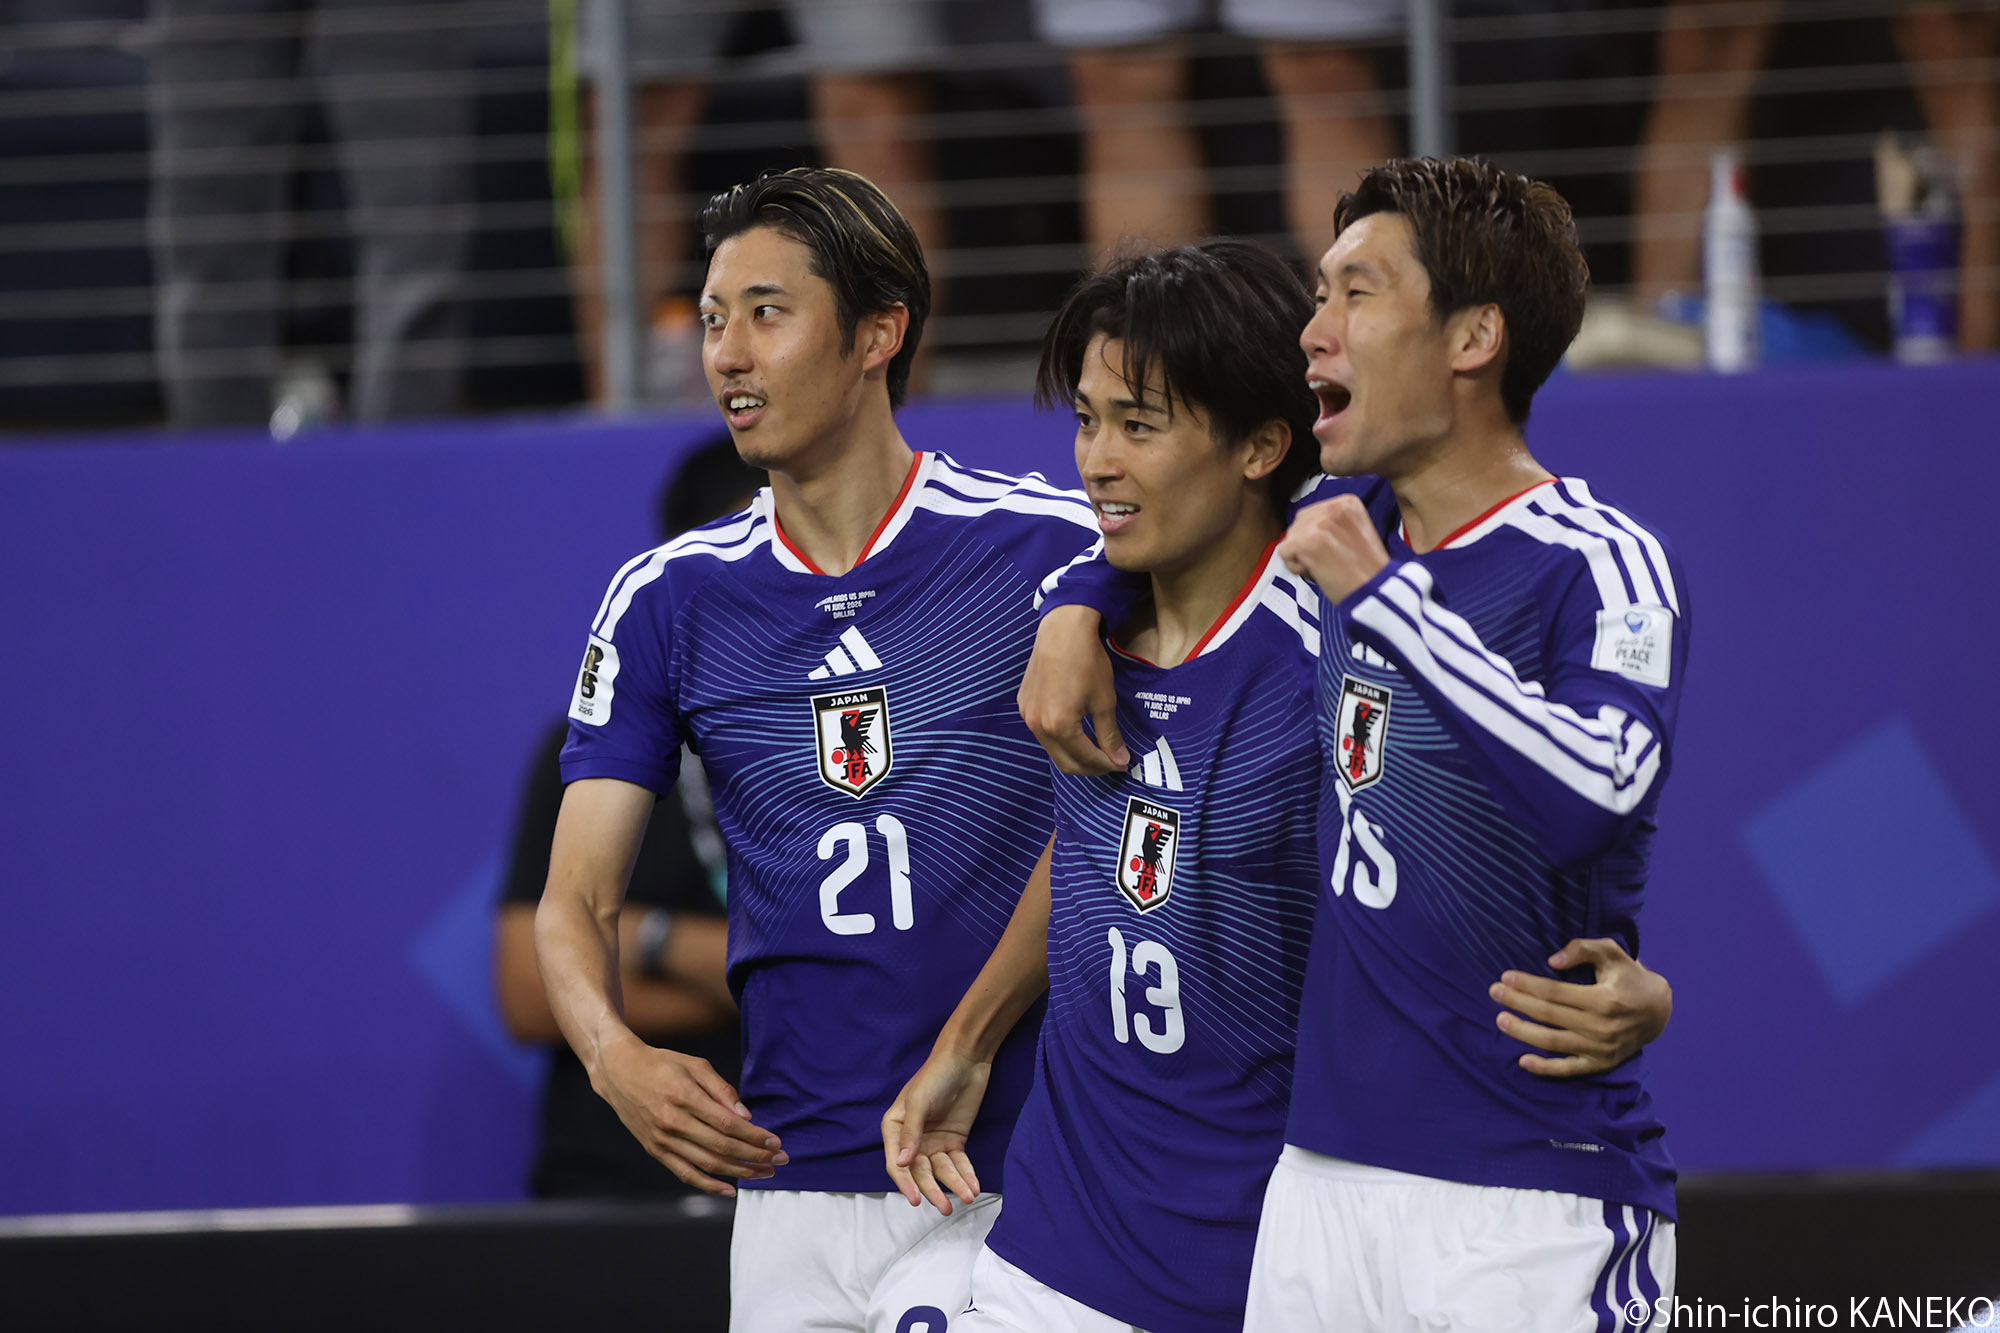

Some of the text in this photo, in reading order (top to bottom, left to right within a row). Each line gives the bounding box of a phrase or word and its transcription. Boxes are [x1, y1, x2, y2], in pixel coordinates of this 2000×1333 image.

[858, 590, 876, 599] JAPAN
[832, 602, 847, 611] JUNE
[847, 600, 862, 609] 2026
[833, 609, 856, 619] DALLAS
[1352, 682, 1381, 700] JAPAN
[830, 693, 868, 707] JAPAN
[1150, 702, 1163, 710] JUNE
[1164, 703, 1178, 712] 2026
[1149, 710, 1169, 720] DALLAS
[840, 762, 873, 781] JFA
[1345, 754, 1368, 774] JFA
[1142, 804, 1168, 821] JAPAN
[1331, 778, 1398, 910] 15
[817, 814, 914, 936] 21
[1132, 874, 1158, 895] JFA
[1107, 926, 1186, 1054] 13
